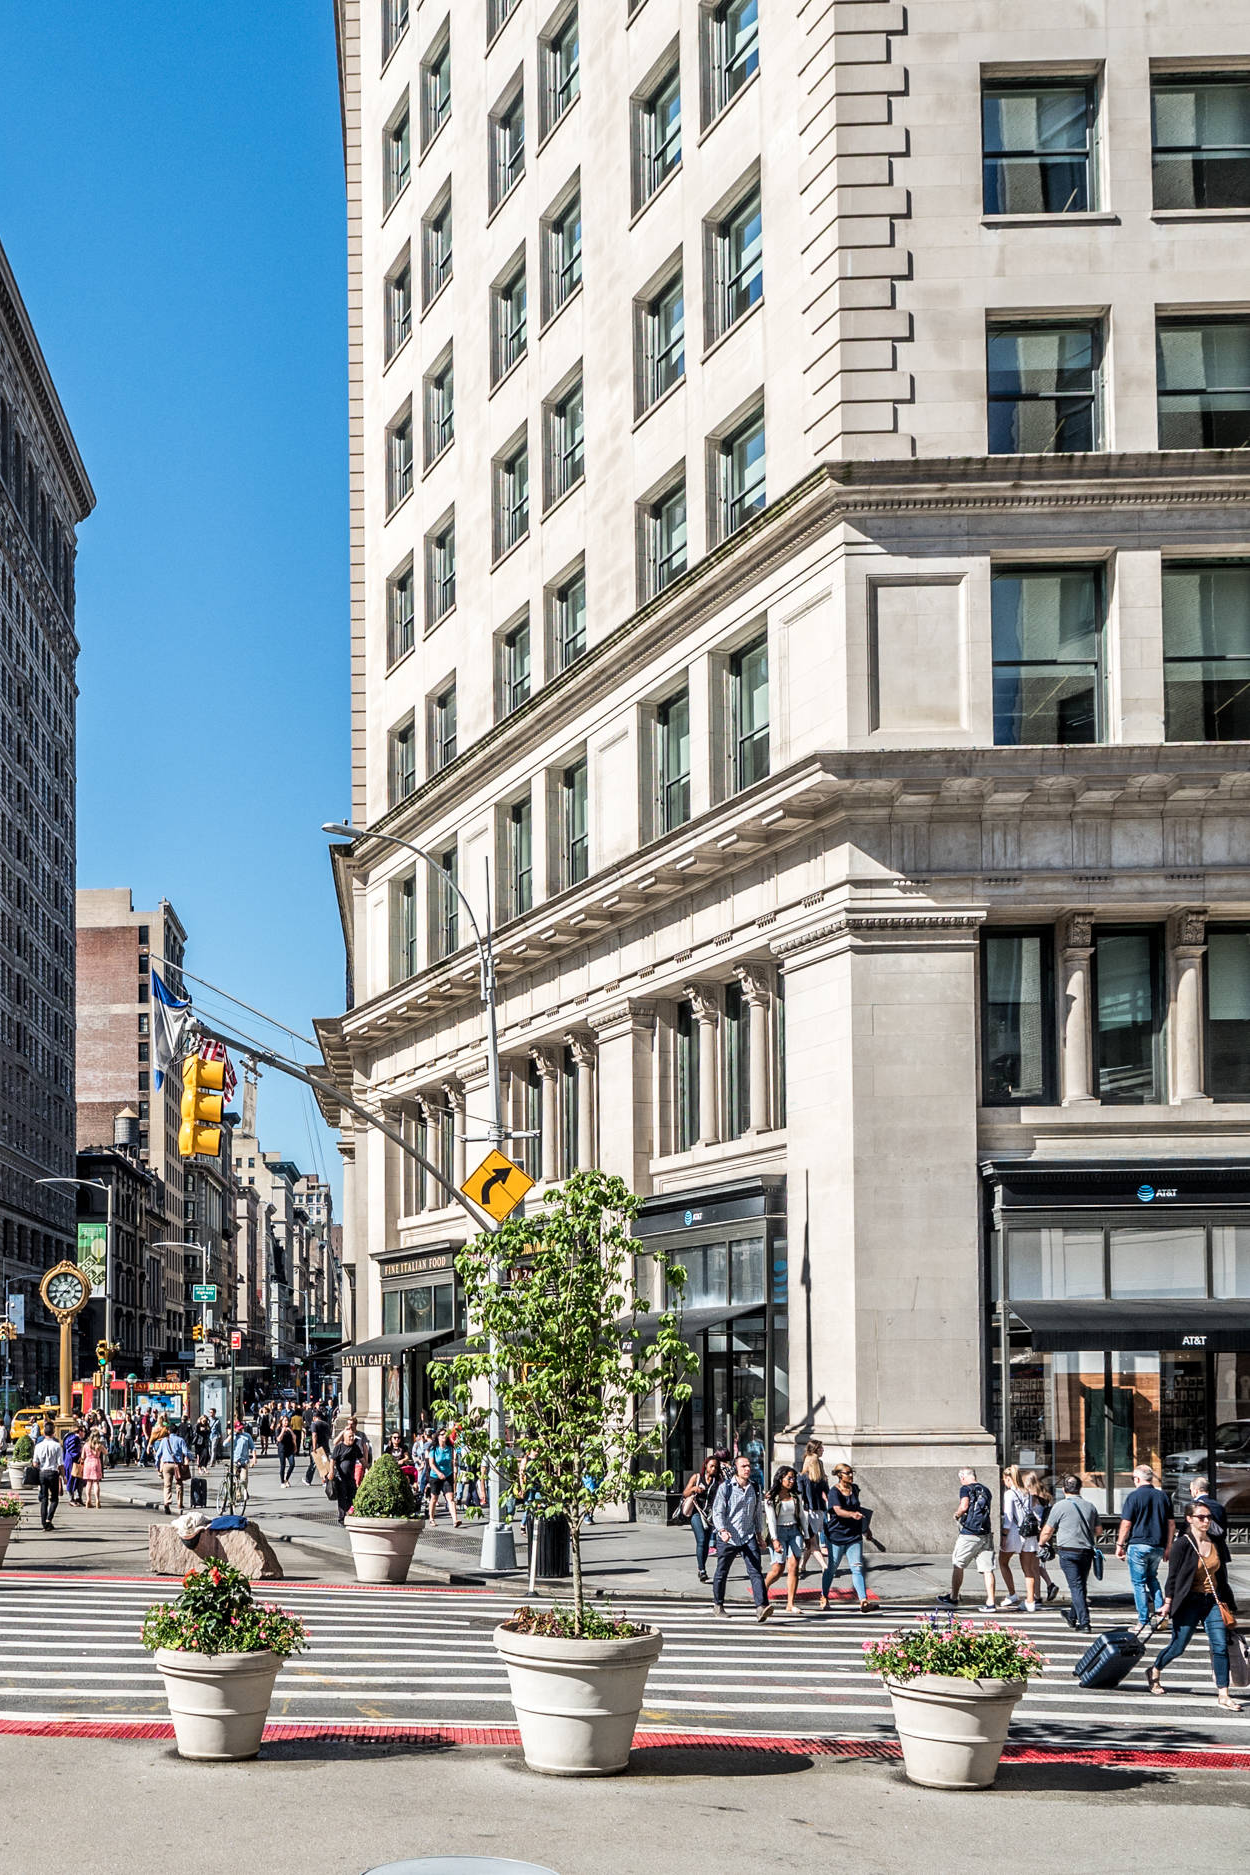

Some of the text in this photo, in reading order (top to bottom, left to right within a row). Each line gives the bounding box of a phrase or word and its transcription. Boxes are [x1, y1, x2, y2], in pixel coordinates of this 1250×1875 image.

[1155, 1188, 1178, 1197] AT&T
[384, 1256, 447, 1276] FINE ITALIAN FOOD
[1182, 1336, 1207, 1346] AT&T
[342, 1354, 366, 1367] EATALY
